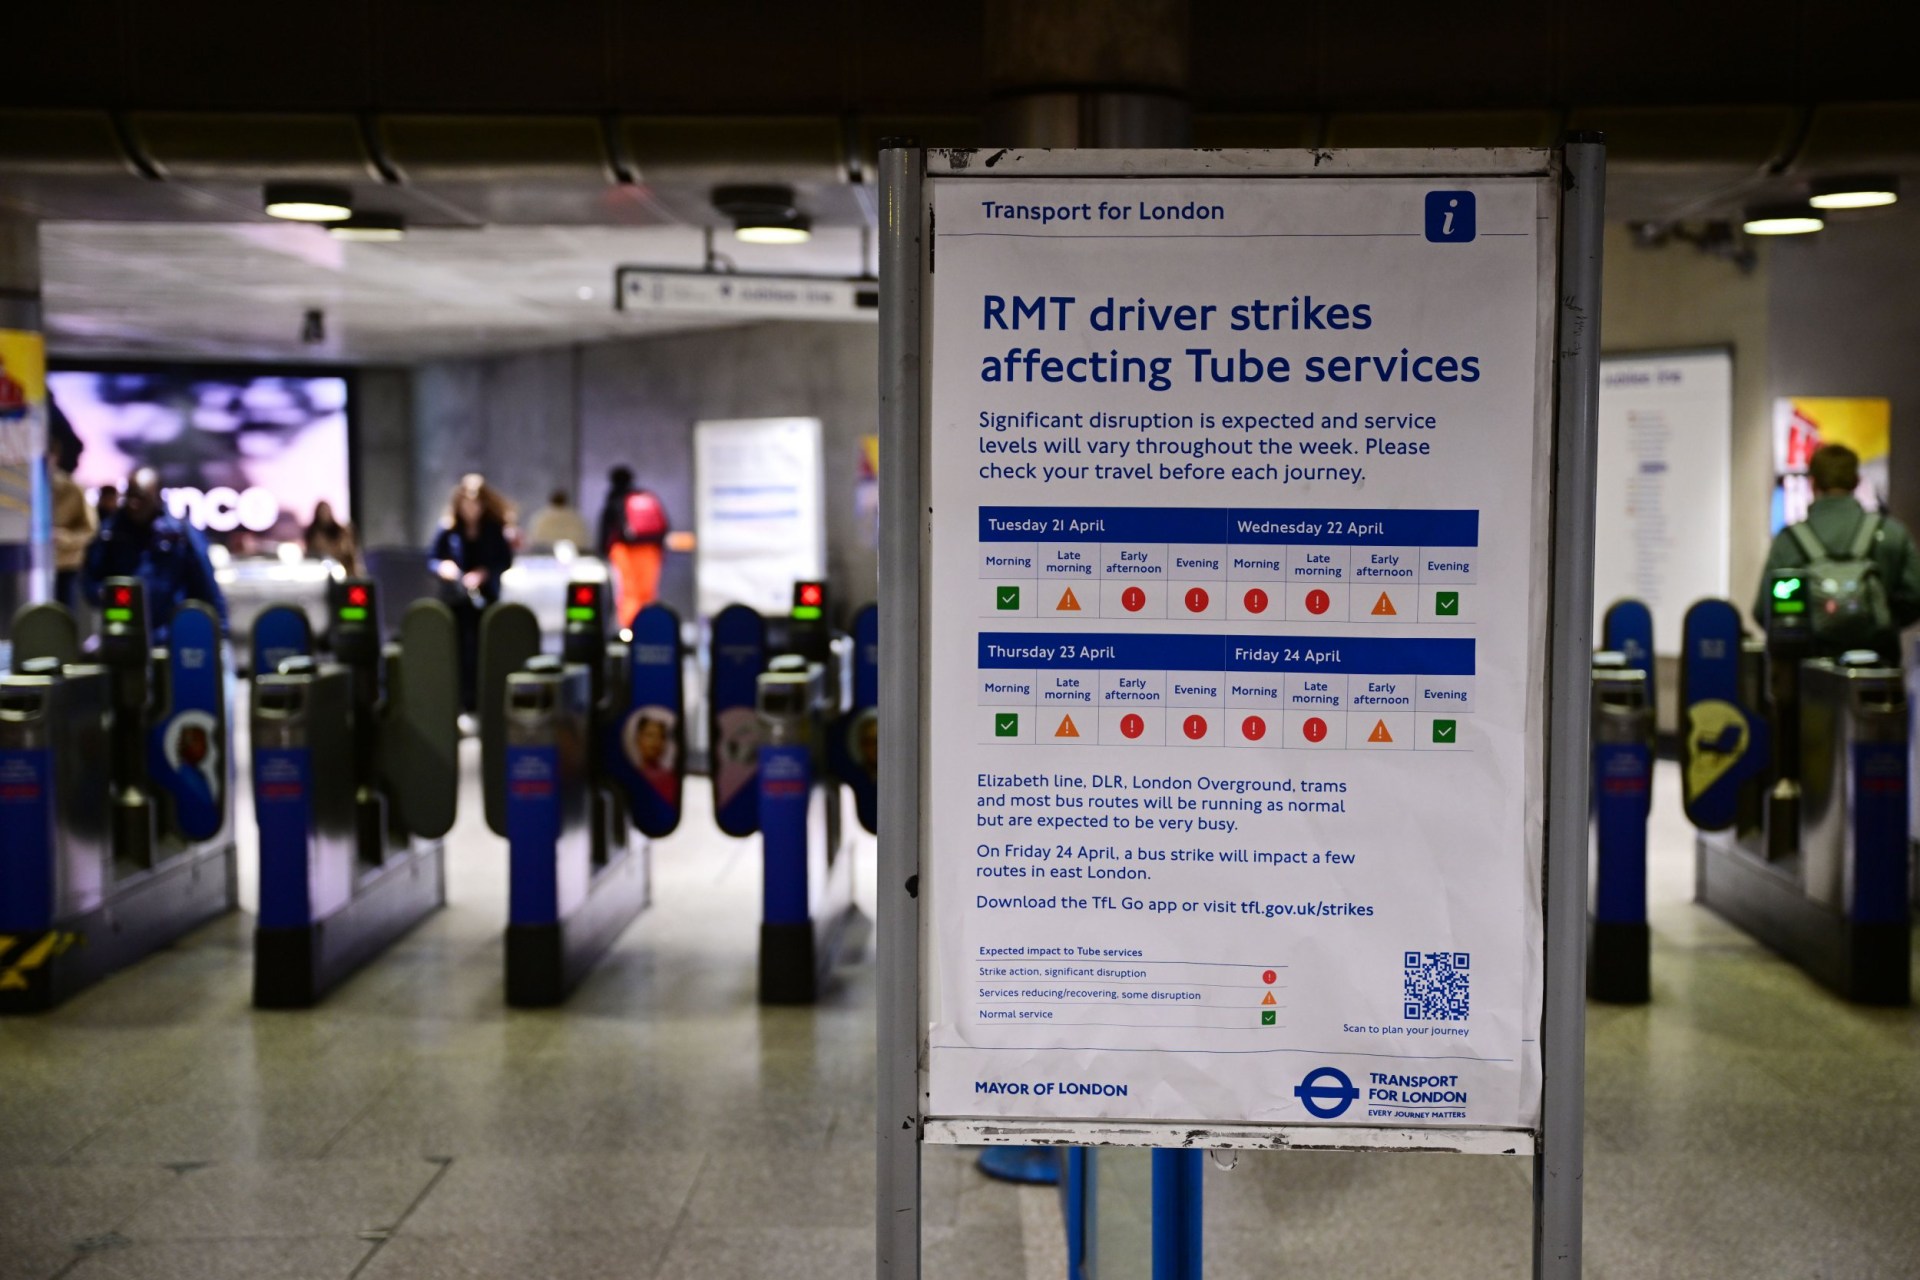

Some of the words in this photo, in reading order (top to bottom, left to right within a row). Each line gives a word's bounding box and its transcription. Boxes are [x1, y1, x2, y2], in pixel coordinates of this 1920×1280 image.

[981, 201, 1092, 225] Transport
[1098, 201, 1132, 221] for
[1139, 201, 1224, 221] London
[984, 295, 1075, 330] RMT
[1090, 298, 1216, 331] driver
[1231, 296, 1371, 330] strikes
[982, 348, 1171, 391] affecting
[1186, 349, 1289, 382] Tube
[1306, 348, 1480, 382] services
[979, 411, 1083, 432] Significant
[1089, 411, 1193, 433] disruption
[1200, 412, 1216, 429] is
[1221, 412, 1314, 433] expected
[1321, 412, 1358, 429] and
[1364, 413, 1436, 430] service
[979, 436, 1038, 454] levels
[1043, 437, 1082, 454] will
[1087, 441, 1131, 458] vary
[1135, 437, 1253, 459] throughout
[1258, 437, 1293, 455] the
[1298, 438, 1359, 455] week.
[1366, 437, 1430, 455] Please
[979, 462, 1037, 479] check
[1042, 466, 1090, 483] your
[1094, 463, 1153, 480] travel
[1159, 462, 1225, 480] before
[1231, 463, 1278, 480] each
[1282, 464, 1366, 485] journey.
[988, 518, 1048, 534] Tuesday
[1052, 518, 1064, 531] 21
[1069, 519, 1105, 534] April
[1237, 520, 1322, 537] Wednesday
[1327, 521, 1343, 534] 22
[1347, 521, 1384, 537] April
[1057, 550, 1081, 560] Late
[1120, 550, 1148, 563] Early
[1306, 553, 1331, 564] Late
[1371, 554, 1399, 567] Early
[986, 556, 1032, 568] Morning
[1106, 563, 1162, 574] afternoon
[1176, 557, 1219, 570] Evening
[1233, 558, 1280, 571] Morning
[1427, 561, 1470, 573] Evening
[1046, 563, 1092, 575] morning
[1294, 567, 1342, 578] morning
[1356, 566, 1413, 577] afternoon
[987, 645, 1055, 661] Thursday
[1059, 645, 1076, 658] 23
[1079, 646, 1116, 661] April
[1235, 647, 1280, 664] Friday
[1284, 648, 1300, 661] 24
[1304, 649, 1341, 665] April
[984, 683, 1030, 695] Morning
[1056, 677, 1080, 688] Late
[1119, 677, 1147, 690] Early
[1304, 681, 1328, 692] Late
[1368, 682, 1396, 695] Early
[1044, 691, 1091, 702] morning
[1104, 690, 1160, 700] afternoon
[1174, 684, 1217, 698] Evening
[1231, 685, 1278, 699] Morning
[1424, 689, 1468, 702] Evening
[1292, 695, 1340, 707] morning
[1353, 694, 1409, 705] afternoon
[977, 773, 1049, 787] Elizabeth
[1054, 774, 1087, 788] line,
[1092, 774, 1127, 790] DLR,
[1133, 775, 1192, 790] London
[1197, 776, 1296, 794] Overground,
[1300, 780, 1347, 793] trams
[977, 793, 1005, 806] and
[1010, 794, 1051, 807] most
[1055, 793, 1084, 808] bus
[1088, 796, 1139, 809] routes
[1143, 796, 1173, 810] will
[1177, 796, 1197, 810] be
[1201, 798, 1263, 815] running
[1267, 801, 1284, 812] as
[1288, 799, 1346, 813] normal
[977, 813, 1004, 827] but
[1008, 816, 1033, 827] are
[1037, 814, 1109, 830] expected
[1113, 816, 1130, 829] to
[1135, 815, 1154, 829] be
[1158, 819, 1194, 833] very
[1198, 816, 1238, 834] busy.
[976, 844, 1000, 858] On
[1005, 844, 1052, 860] Friday
[1056, 845, 1073, 859] 24
[1077, 845, 1119, 861] April,
[1124, 849, 1133, 860] a
[1138, 847, 1166, 861] bus
[1170, 848, 1214, 862] strike
[1218, 849, 1249, 863] will
[1253, 851, 1308, 866] impact
[1312, 853, 1321, 864] a
[1325, 850, 1356, 864] few
[976, 865, 1027, 878] routes
[1031, 867, 1045, 878] in
[1050, 866, 1083, 879] east
[1087, 865, 1151, 880] London.
[976, 895, 1056, 909] Download
[1060, 895, 1088, 909] the
[1091, 896, 1117, 910] TfL
[1121, 896, 1144, 910] Go
[1148, 900, 1178, 914] app
[1181, 901, 1200, 912] or
[1203, 901, 1237, 914] visit
[1240, 900, 1374, 918] tfl.gov.uk/strikes
[979, 946, 1025, 957] Expected
[1027, 947, 1061, 957] impact
[1063, 947, 1075, 956] to
[1077, 946, 1101, 956] Tube
[1103, 948, 1143, 957] services
[979, 967, 1007, 976] Strike
[1009, 967, 1041, 976] action,
[1044, 967, 1095, 978] significant
[1096, 967, 1147, 979] disruption
[979, 988, 1019, 998] Services
[1021, 988, 1118, 1000] reducing/recovering,
[1121, 991, 1149, 1000] some
[1150, 991, 1201, 1001] disruption
[979, 1010, 1017, 1019] Normal
[1018, 1010, 1053, 1019] service
[1343, 1023, 1366, 1033] Scan
[1368, 1025, 1380, 1034] to
[1382, 1025, 1404, 1036] plan
[1405, 1027, 1430, 1036] your
[1430, 1026, 1470, 1038] journey
[1369, 1072, 1459, 1088] TRANSPORT
[975, 1081, 1030, 1095] MAYOR
[1033, 1082, 1055, 1096] OF
[1058, 1082, 1128, 1097] LONDON
[1368, 1088, 1398, 1102] FOR
[1402, 1090, 1467, 1104] LONDON
[1368, 1109, 1393, 1117] EVERY
[1394, 1111, 1430, 1119] JOURNEY
[1431, 1111, 1466, 1119] MATTERS
